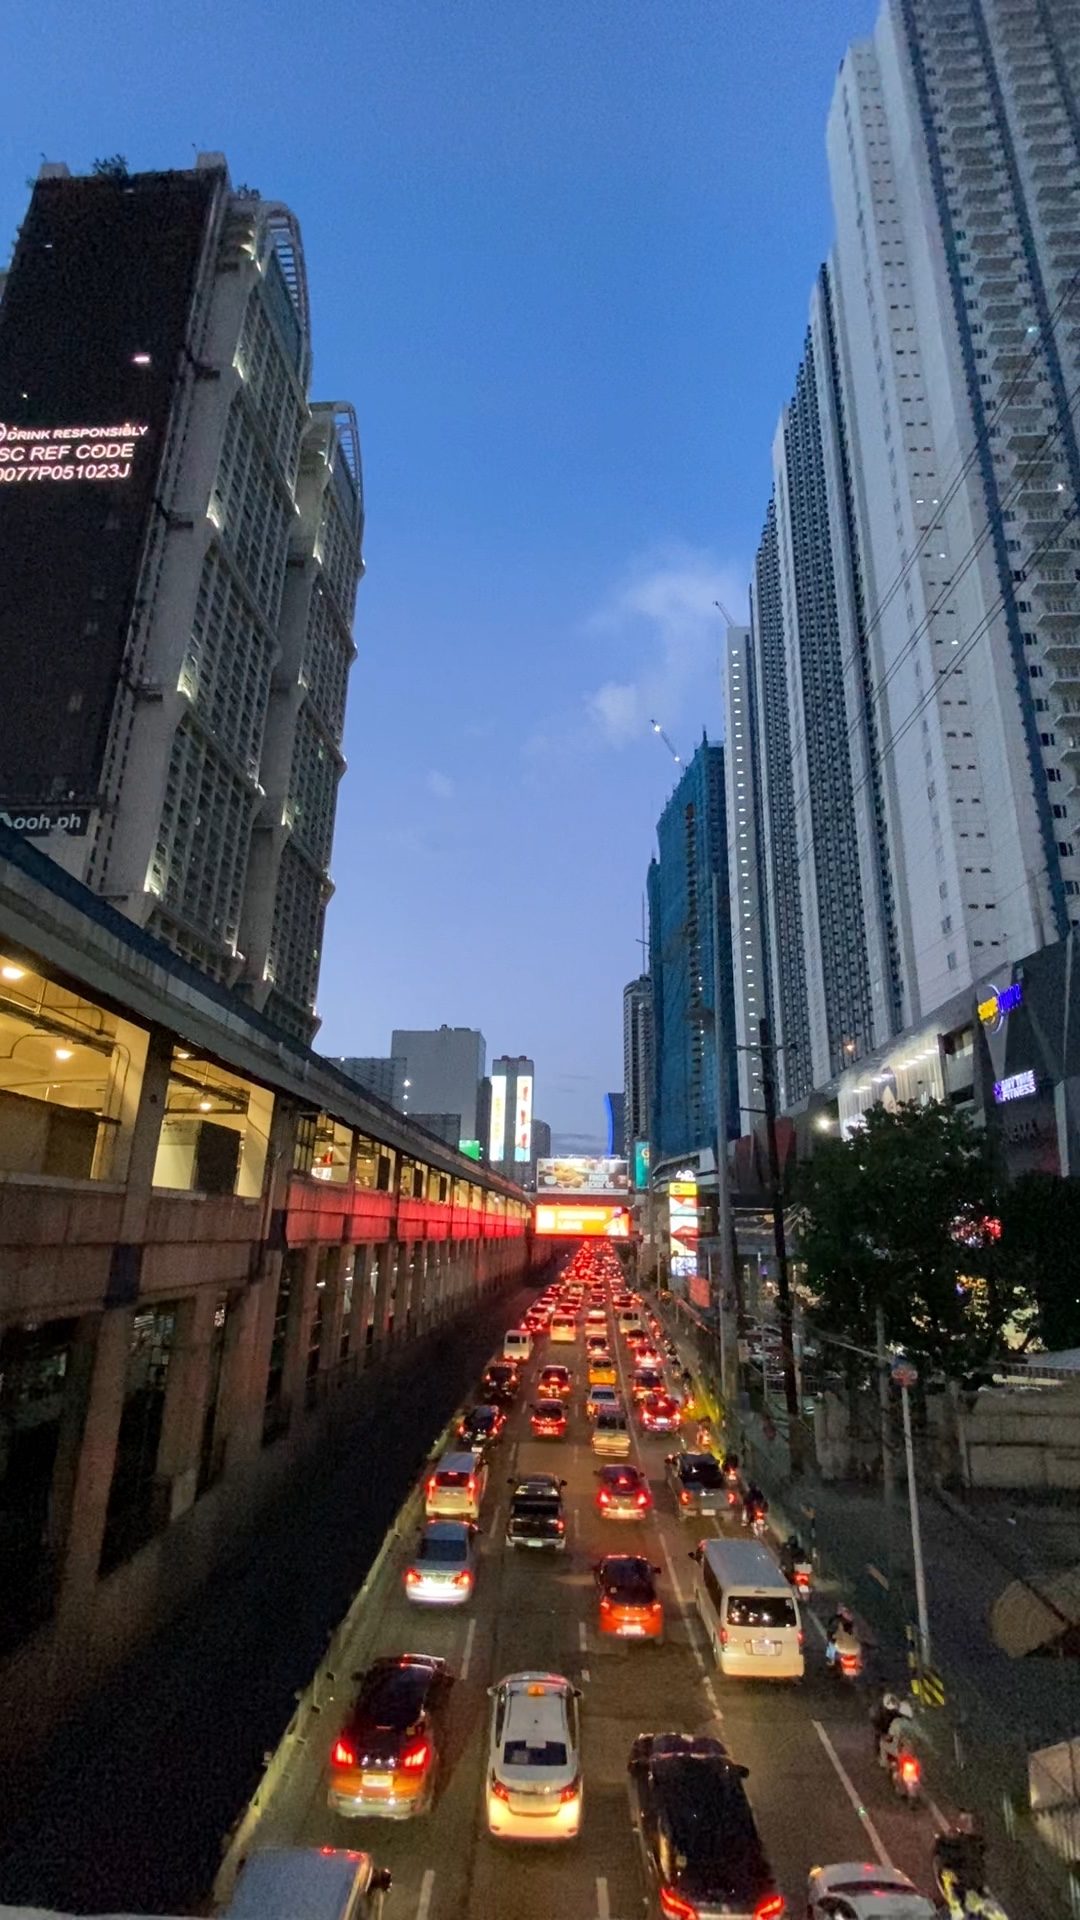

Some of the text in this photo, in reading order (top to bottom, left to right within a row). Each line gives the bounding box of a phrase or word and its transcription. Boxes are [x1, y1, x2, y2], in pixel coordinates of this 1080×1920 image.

[7, 426, 148, 440] DRINK RESPONSIBLY
[30, 445, 71, 461] REF
[76, 443, 135, 459] CODE
[1002, 1084, 1037, 1101] FITNESS
